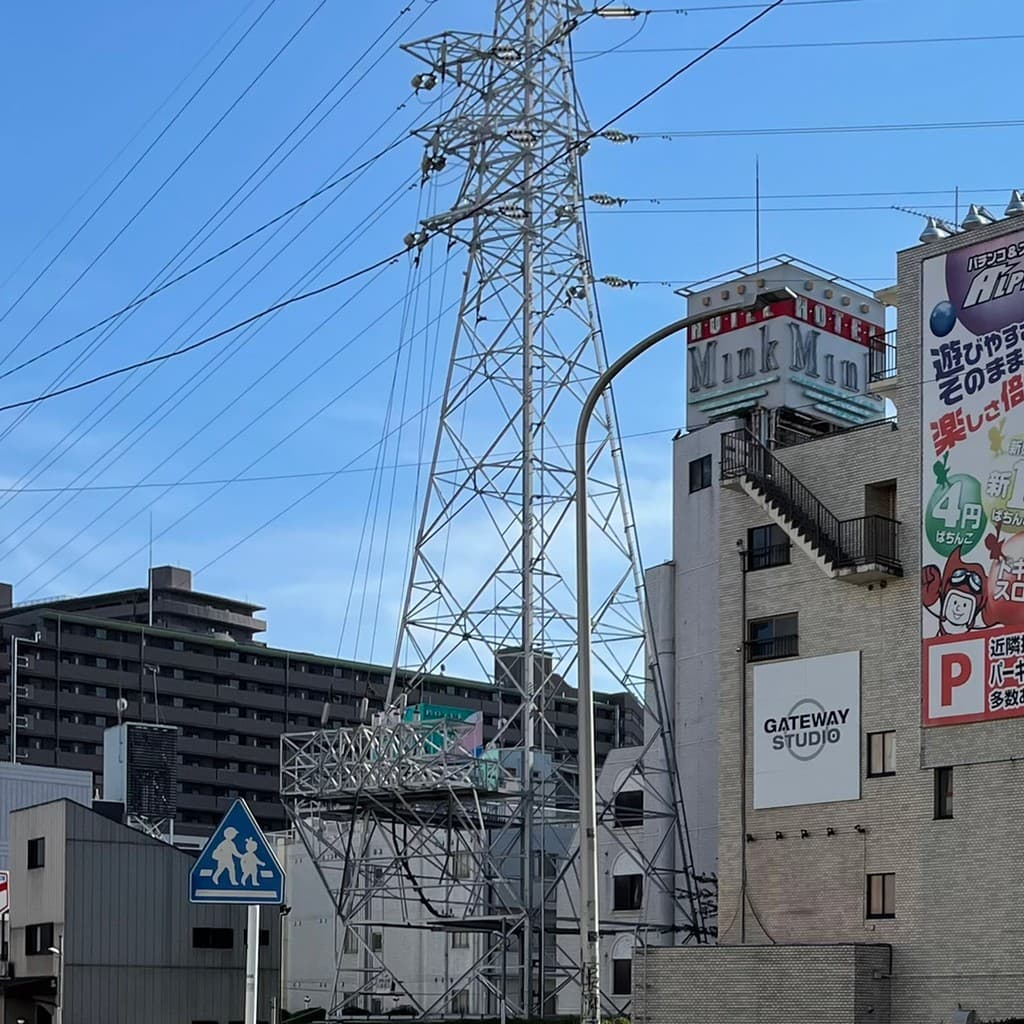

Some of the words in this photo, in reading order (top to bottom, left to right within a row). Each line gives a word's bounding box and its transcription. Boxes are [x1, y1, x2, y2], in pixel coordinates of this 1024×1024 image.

[940, 652, 973, 707] P
[764, 708, 850, 733] GATEWAY
[772, 728, 841, 750] STUDIO
